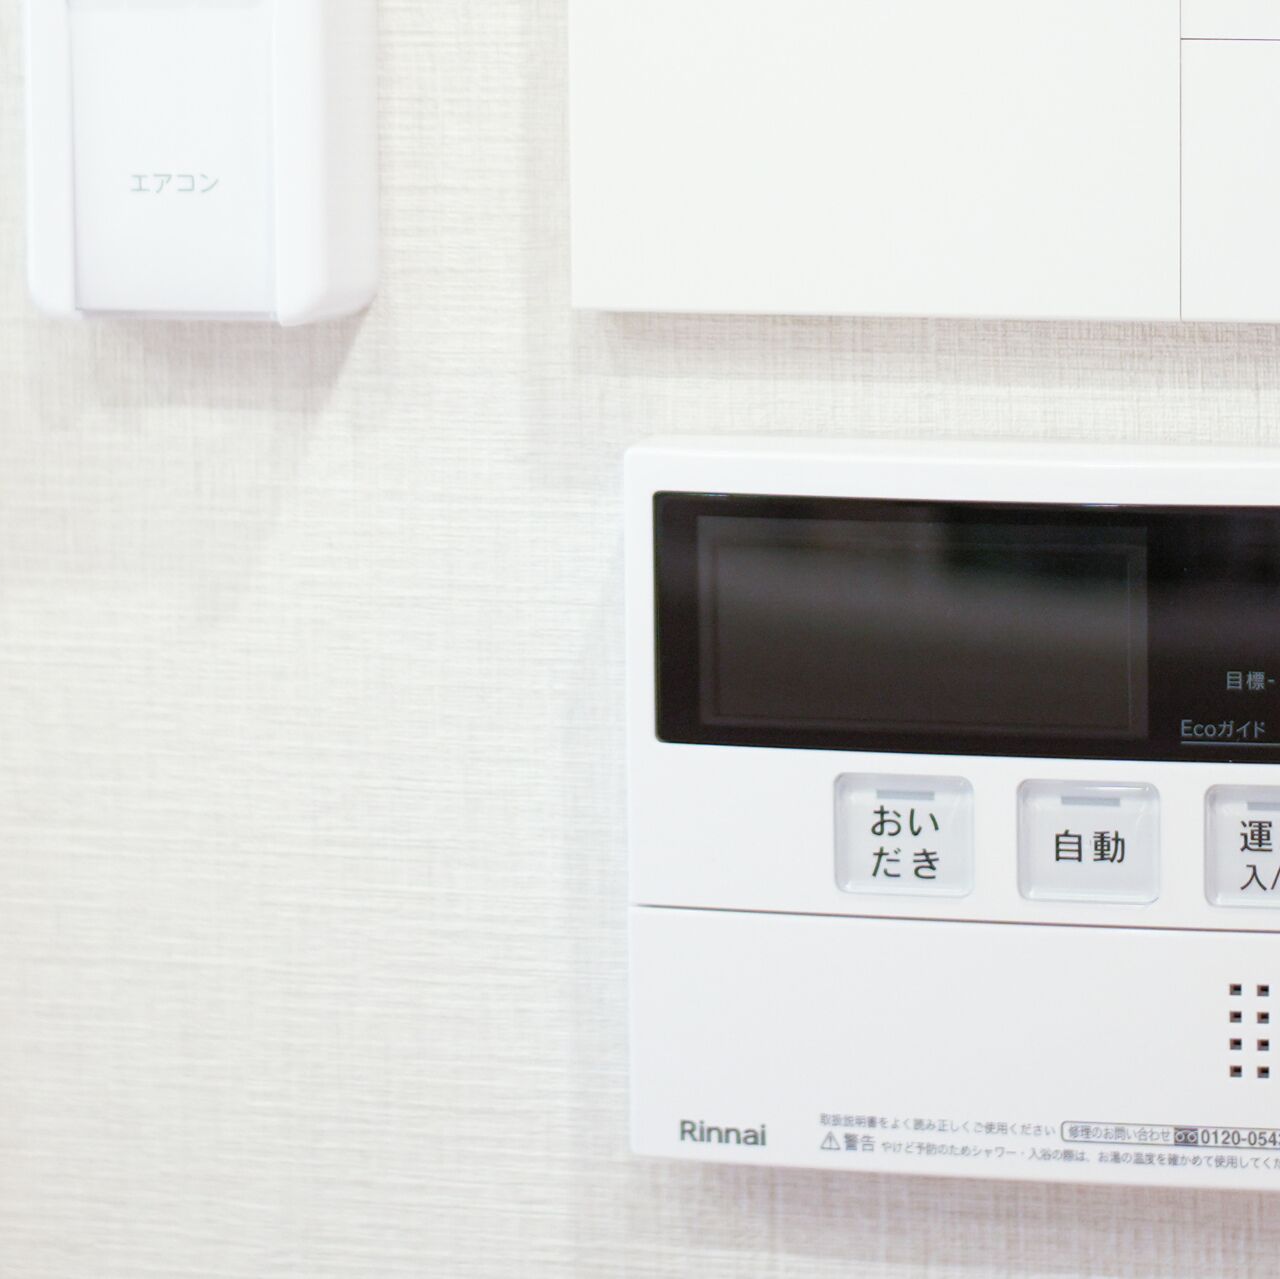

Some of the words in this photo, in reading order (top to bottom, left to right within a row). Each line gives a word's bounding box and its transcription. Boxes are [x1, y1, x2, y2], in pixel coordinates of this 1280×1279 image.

[130, 173, 219, 194] エアコン
[1180, 719, 1265, 739] Ecoガイド
[870, 804, 940, 838] おい
[1053, 829, 1126, 864] 自動
[871, 846, 940, 880] だき
[679, 1119, 767, 1147] Rinnai
[844, 1133, 876, 1152] 警告
